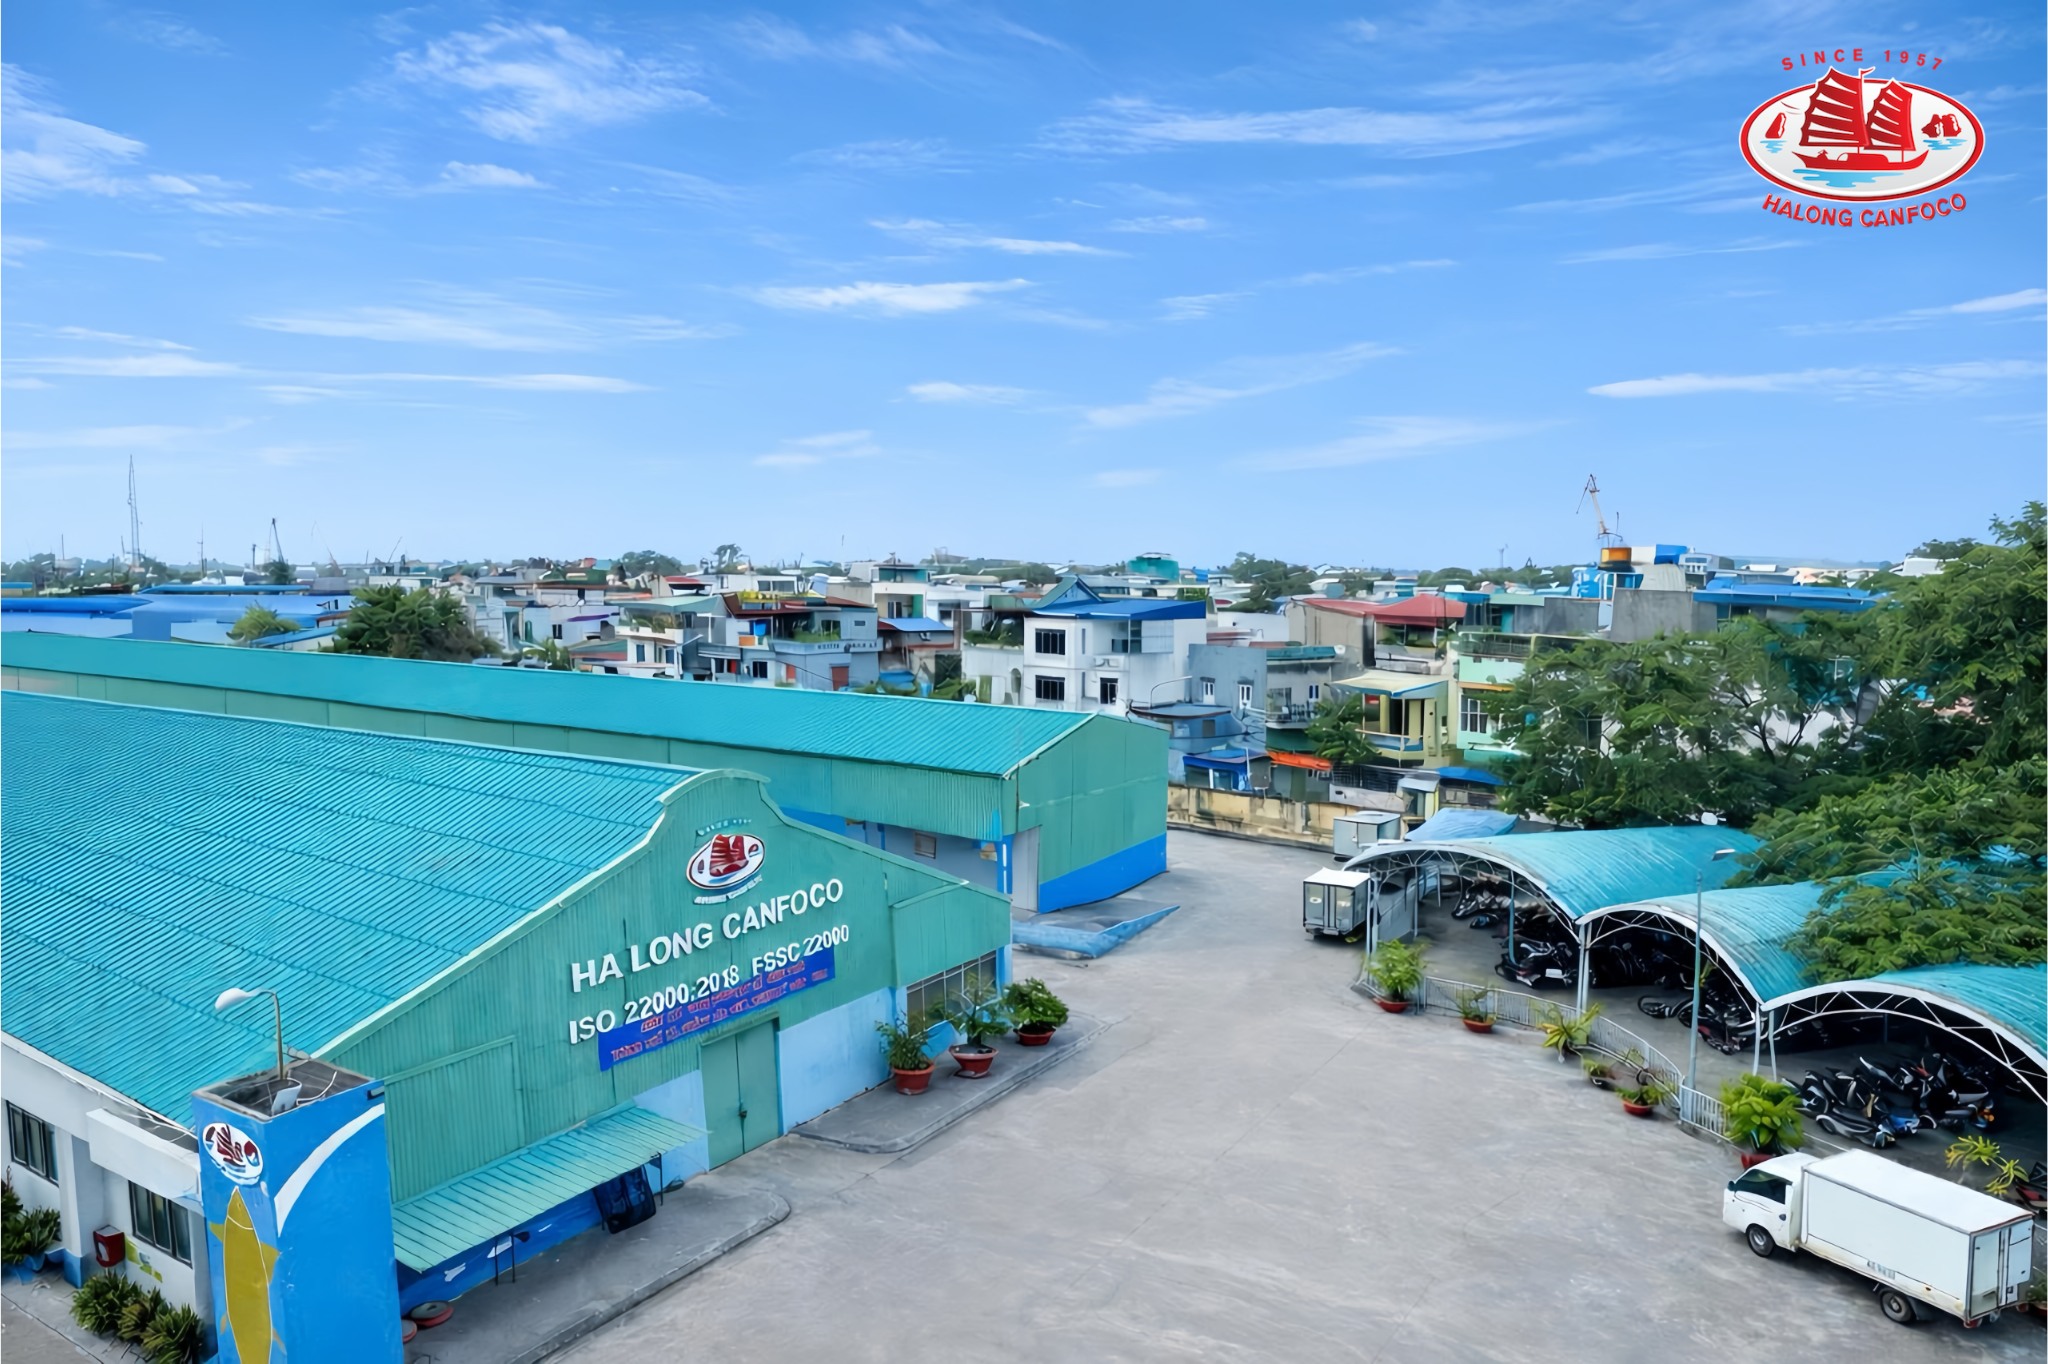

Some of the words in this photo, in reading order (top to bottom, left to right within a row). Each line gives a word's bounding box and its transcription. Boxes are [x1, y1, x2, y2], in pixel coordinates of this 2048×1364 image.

[569, 1009, 616, 1045] ISO
[624, 965, 740, 1025] 22000:2018
[752, 943, 801, 976] FSSC
[803, 924, 850, 957] 22000
[571, 953, 624, 993] HA
[630, 922, 714, 973] LONG
[722, 878, 844, 940] CANFOCO
